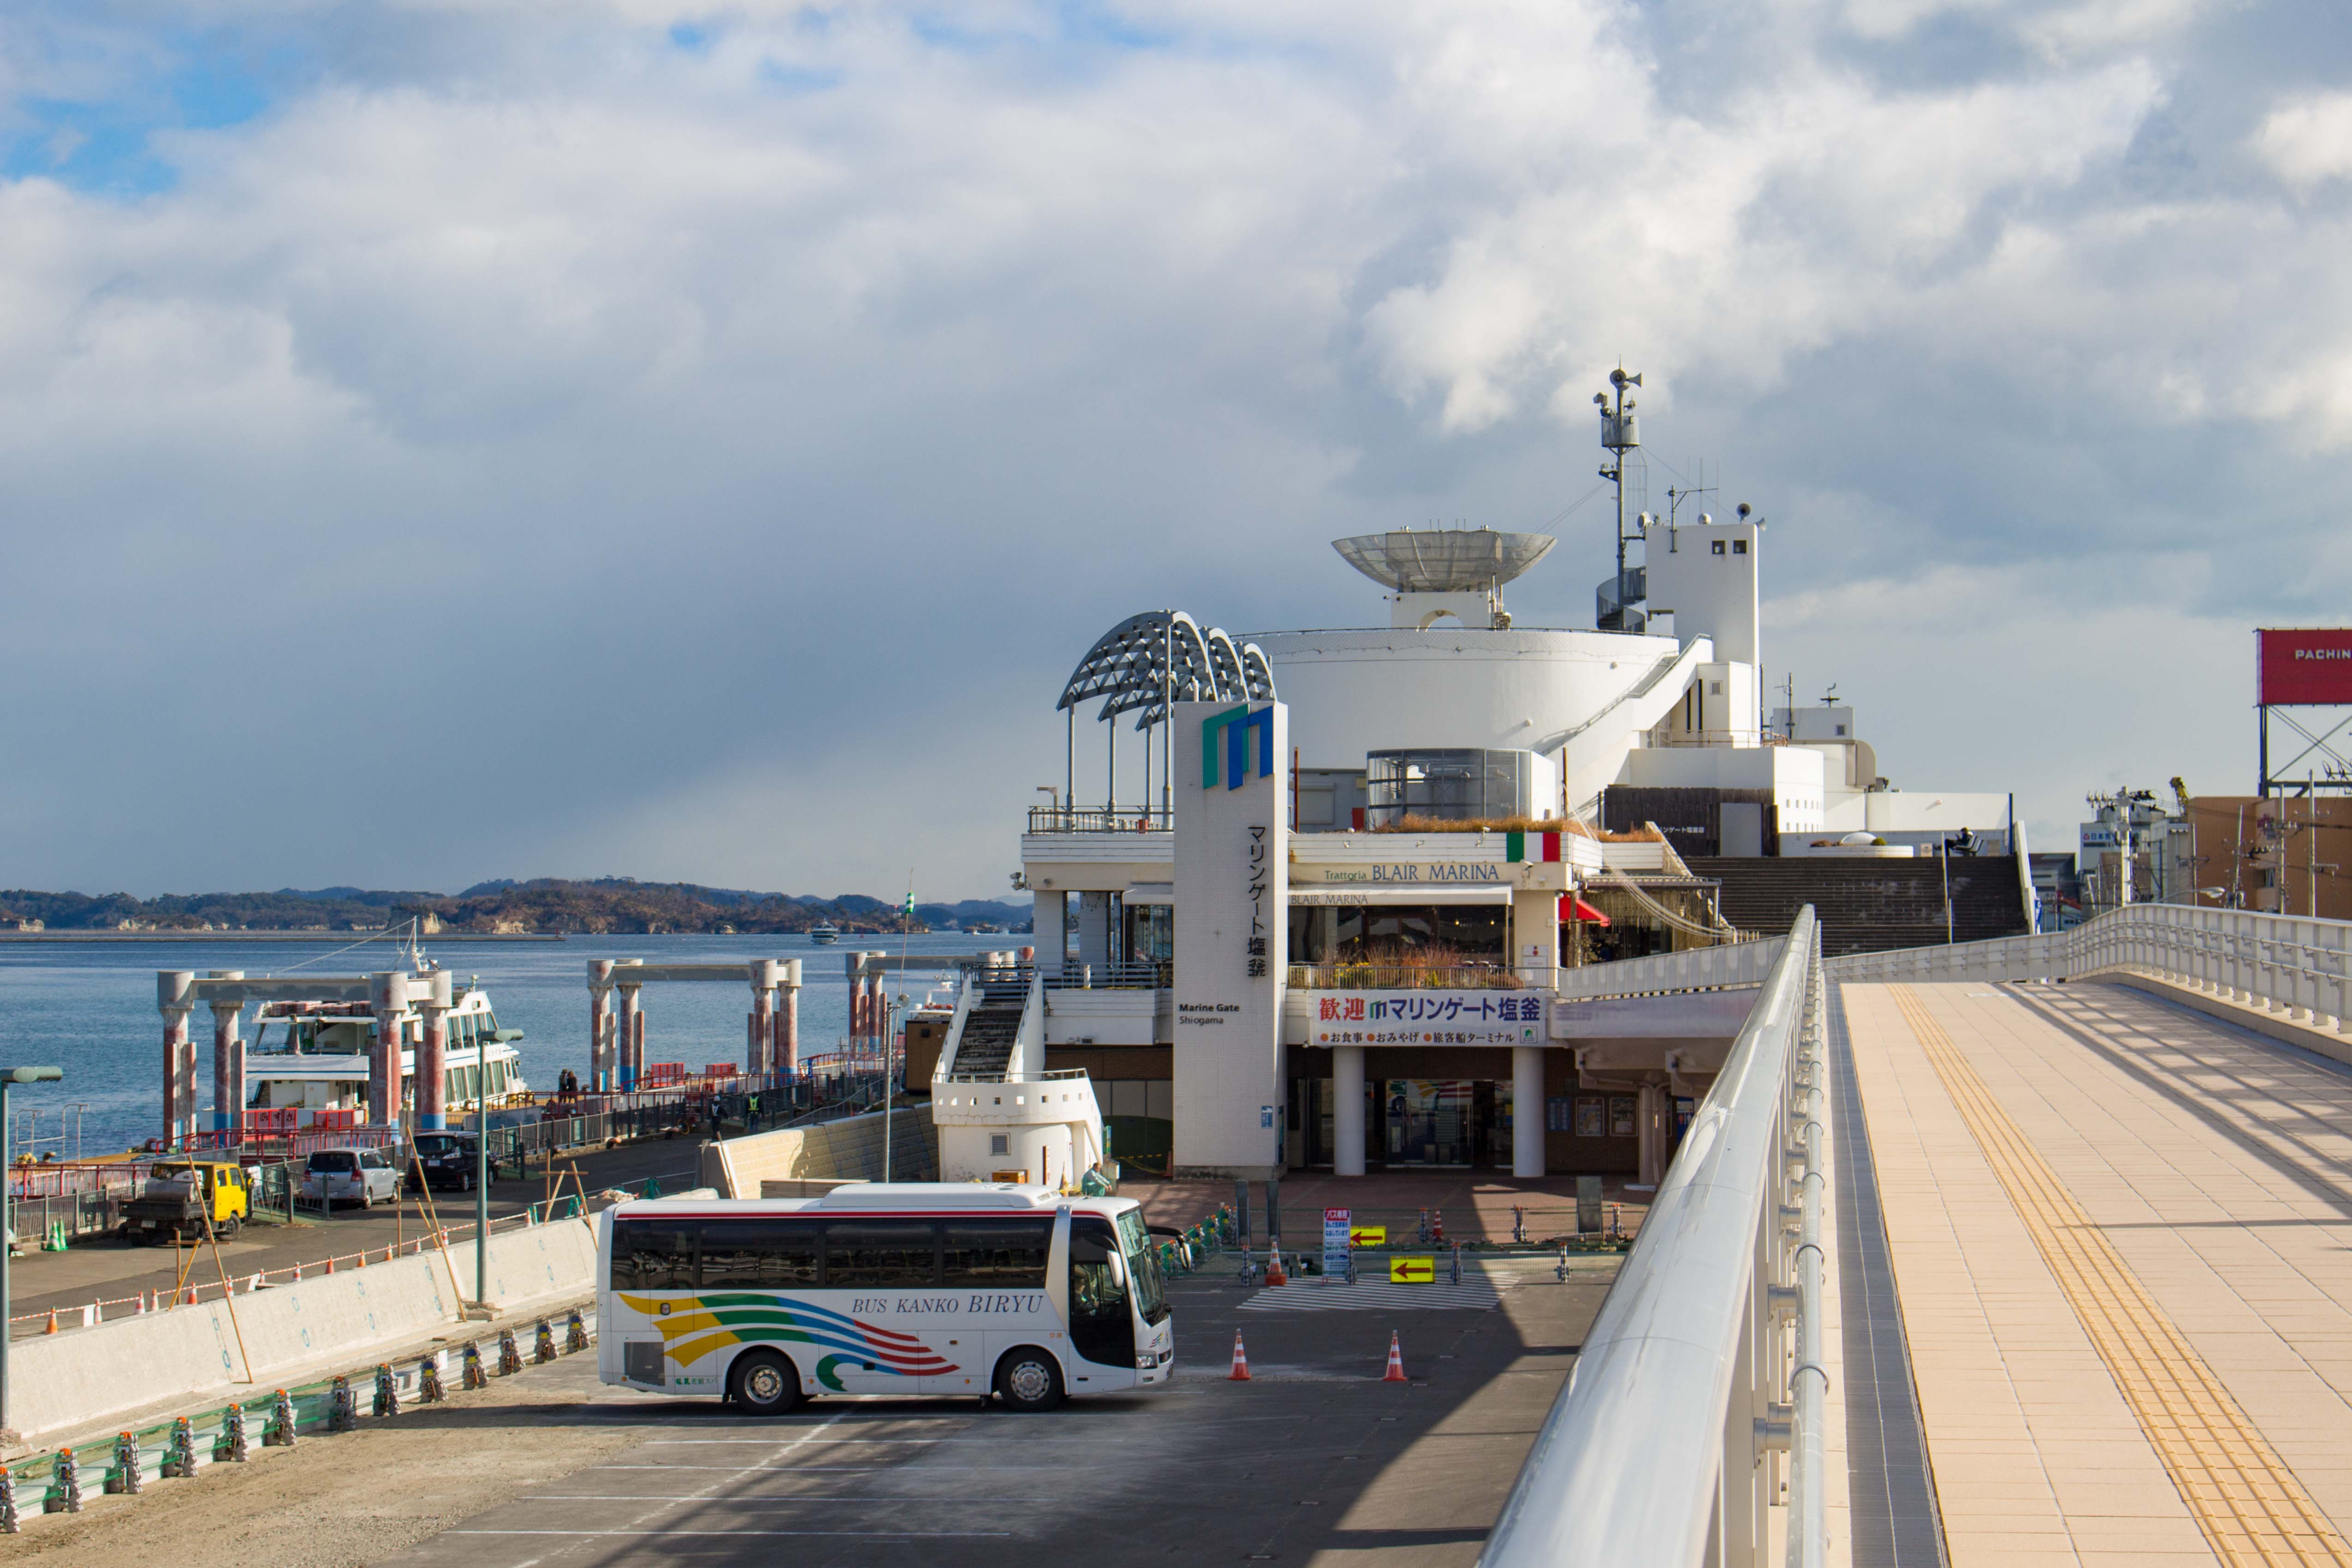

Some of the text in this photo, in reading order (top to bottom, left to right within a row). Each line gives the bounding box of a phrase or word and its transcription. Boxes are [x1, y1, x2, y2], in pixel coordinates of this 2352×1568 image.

[1324, 864, 1499, 881] Trattoria BLAIR MARINA
[1247, 826, 1266, 976] マリンゲート塩釜
[1291, 894, 1368, 905] BLAIR MARINA
[1179, 1003, 1240, 1012] Marine Gate
[1319, 997, 1540, 1022] 歓迎 マリンゲート塩釜
[1179, 1016, 1224, 1026] Shiogama
[1331, 1031, 1515, 1043] お食事 おみやげ 旅客船ターミナル
[852, 1295, 1044, 1313] BUS KANKO BIRYU
